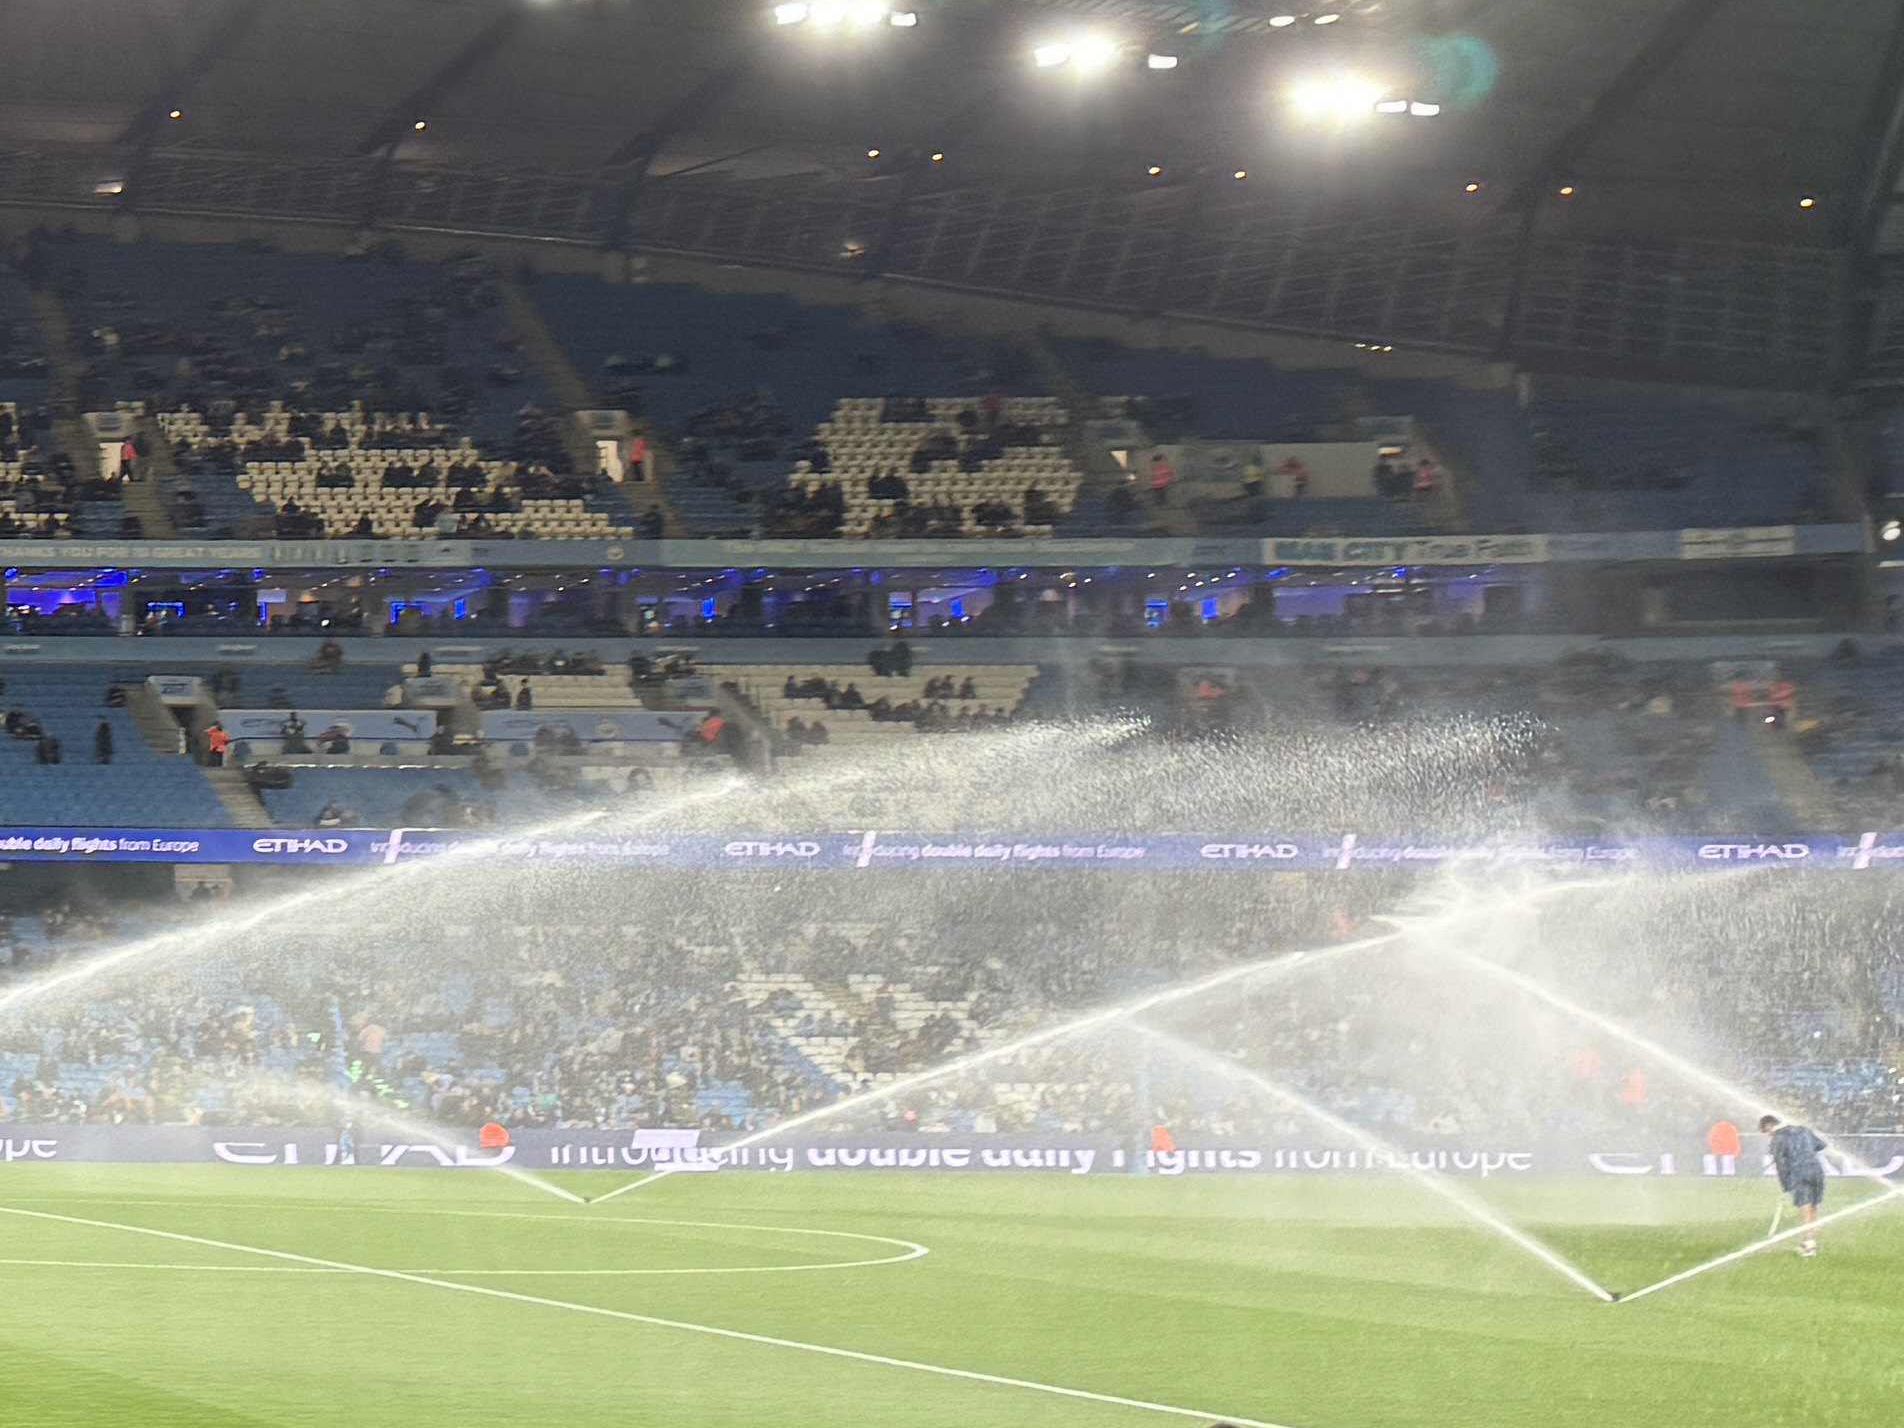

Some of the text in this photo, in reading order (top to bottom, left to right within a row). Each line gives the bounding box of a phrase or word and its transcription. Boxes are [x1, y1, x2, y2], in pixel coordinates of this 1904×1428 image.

[33, 837, 70, 853] daily
[71, 837, 118, 854] flights
[118, 838, 151, 851] from
[152, 838, 200, 853] Europe
[252, 838, 348, 853] ETIHAD
[724, 840, 821, 858] ETIHAD
[1200, 843, 1299, 859] ETIHAD
[1697, 843, 1810, 859] ETIHAD
